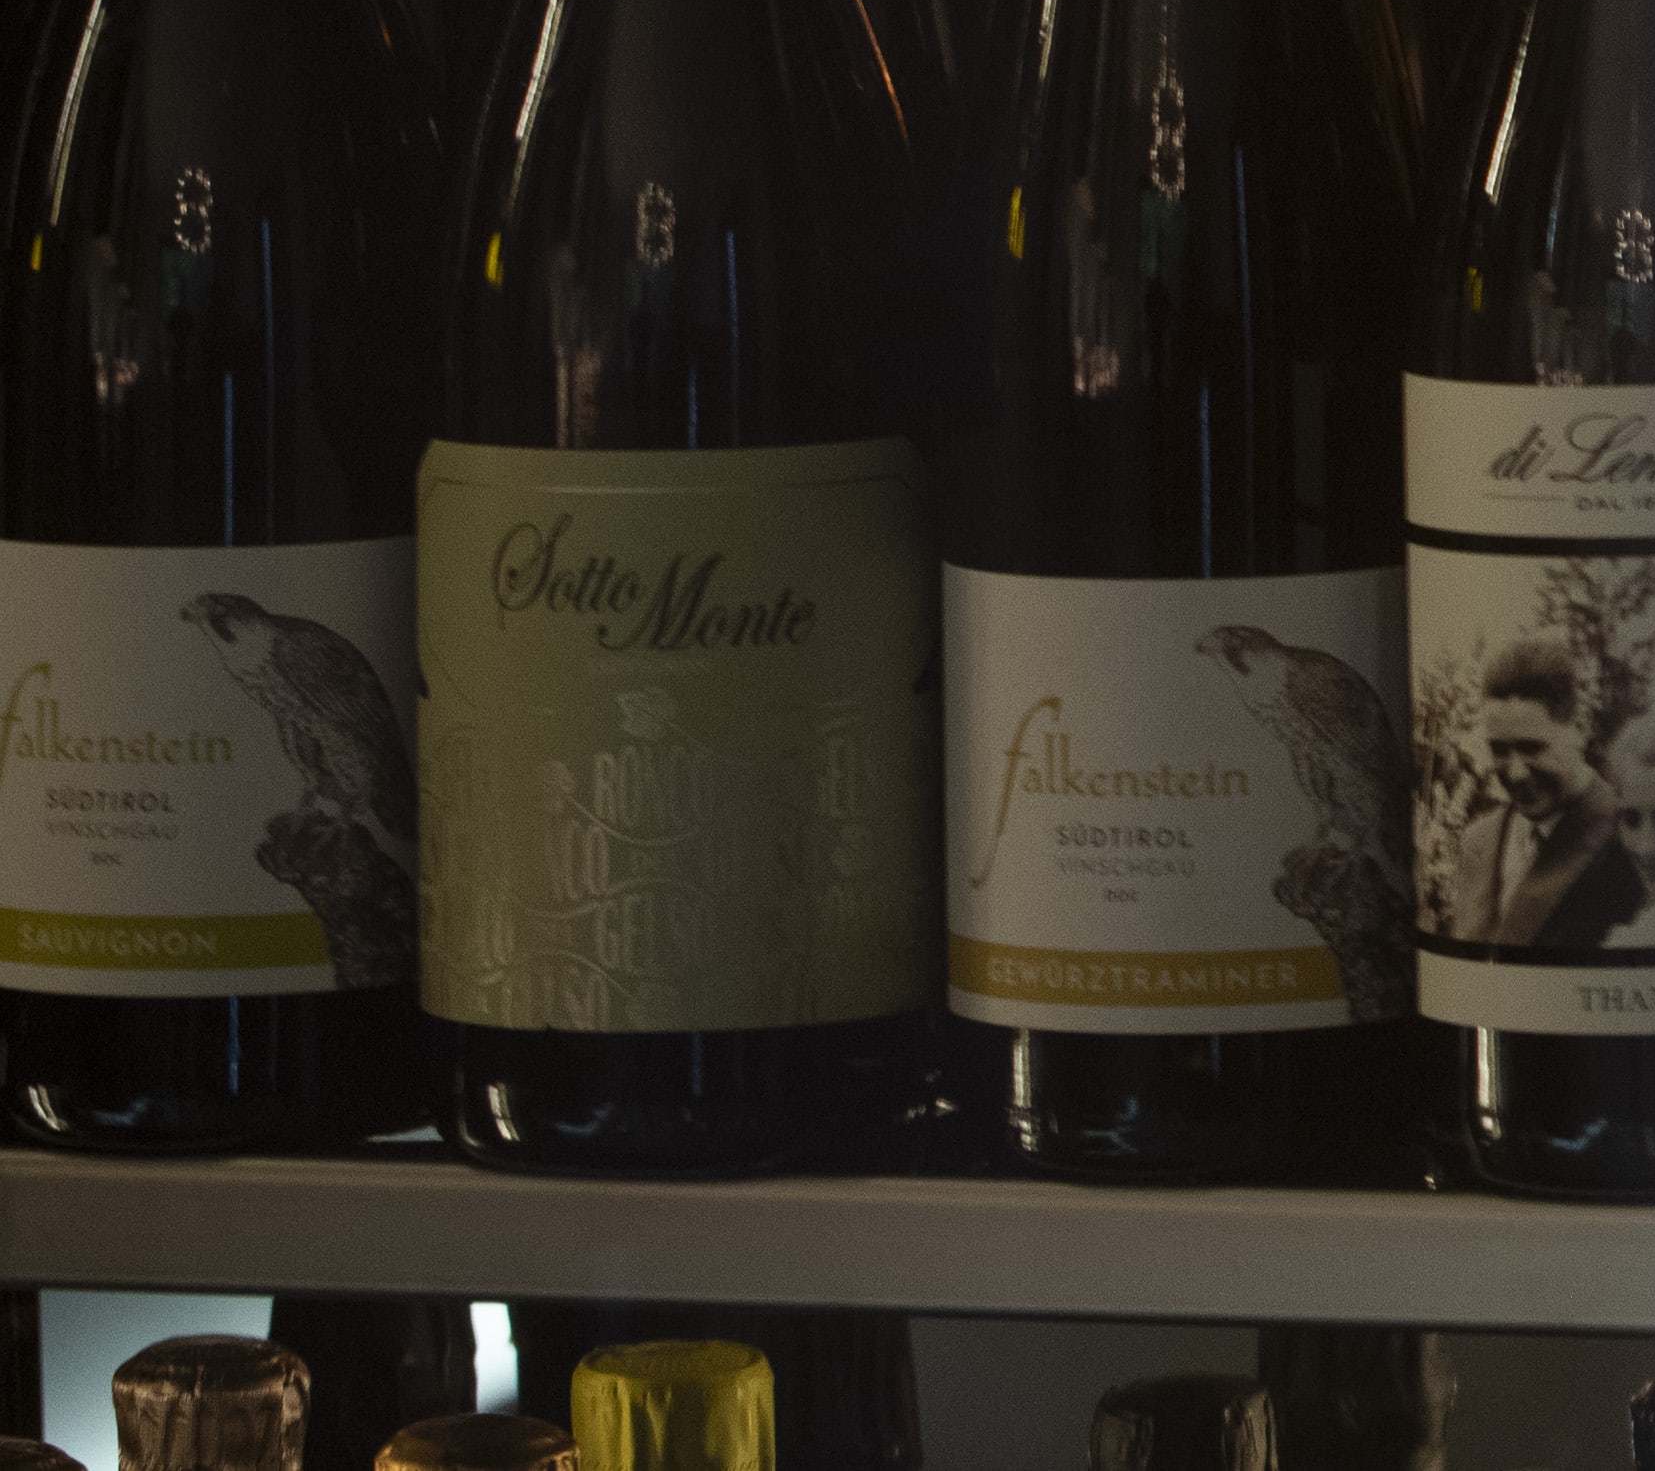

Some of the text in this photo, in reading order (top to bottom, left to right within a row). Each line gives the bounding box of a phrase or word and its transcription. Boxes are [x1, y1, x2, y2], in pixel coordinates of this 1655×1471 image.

[1489, 424, 1553, 482] di
[1575, 495, 1625, 512] DAL
[492, 513, 817, 651] Sotto Monte
[970, 696, 1249, 890] falkenstein
[1056, 822, 1194, 849] SÜDTIROL
[19, 922, 218, 957] SAUVIGNON
[986, 957, 1298, 994] GEWÜRZTRAMINER
